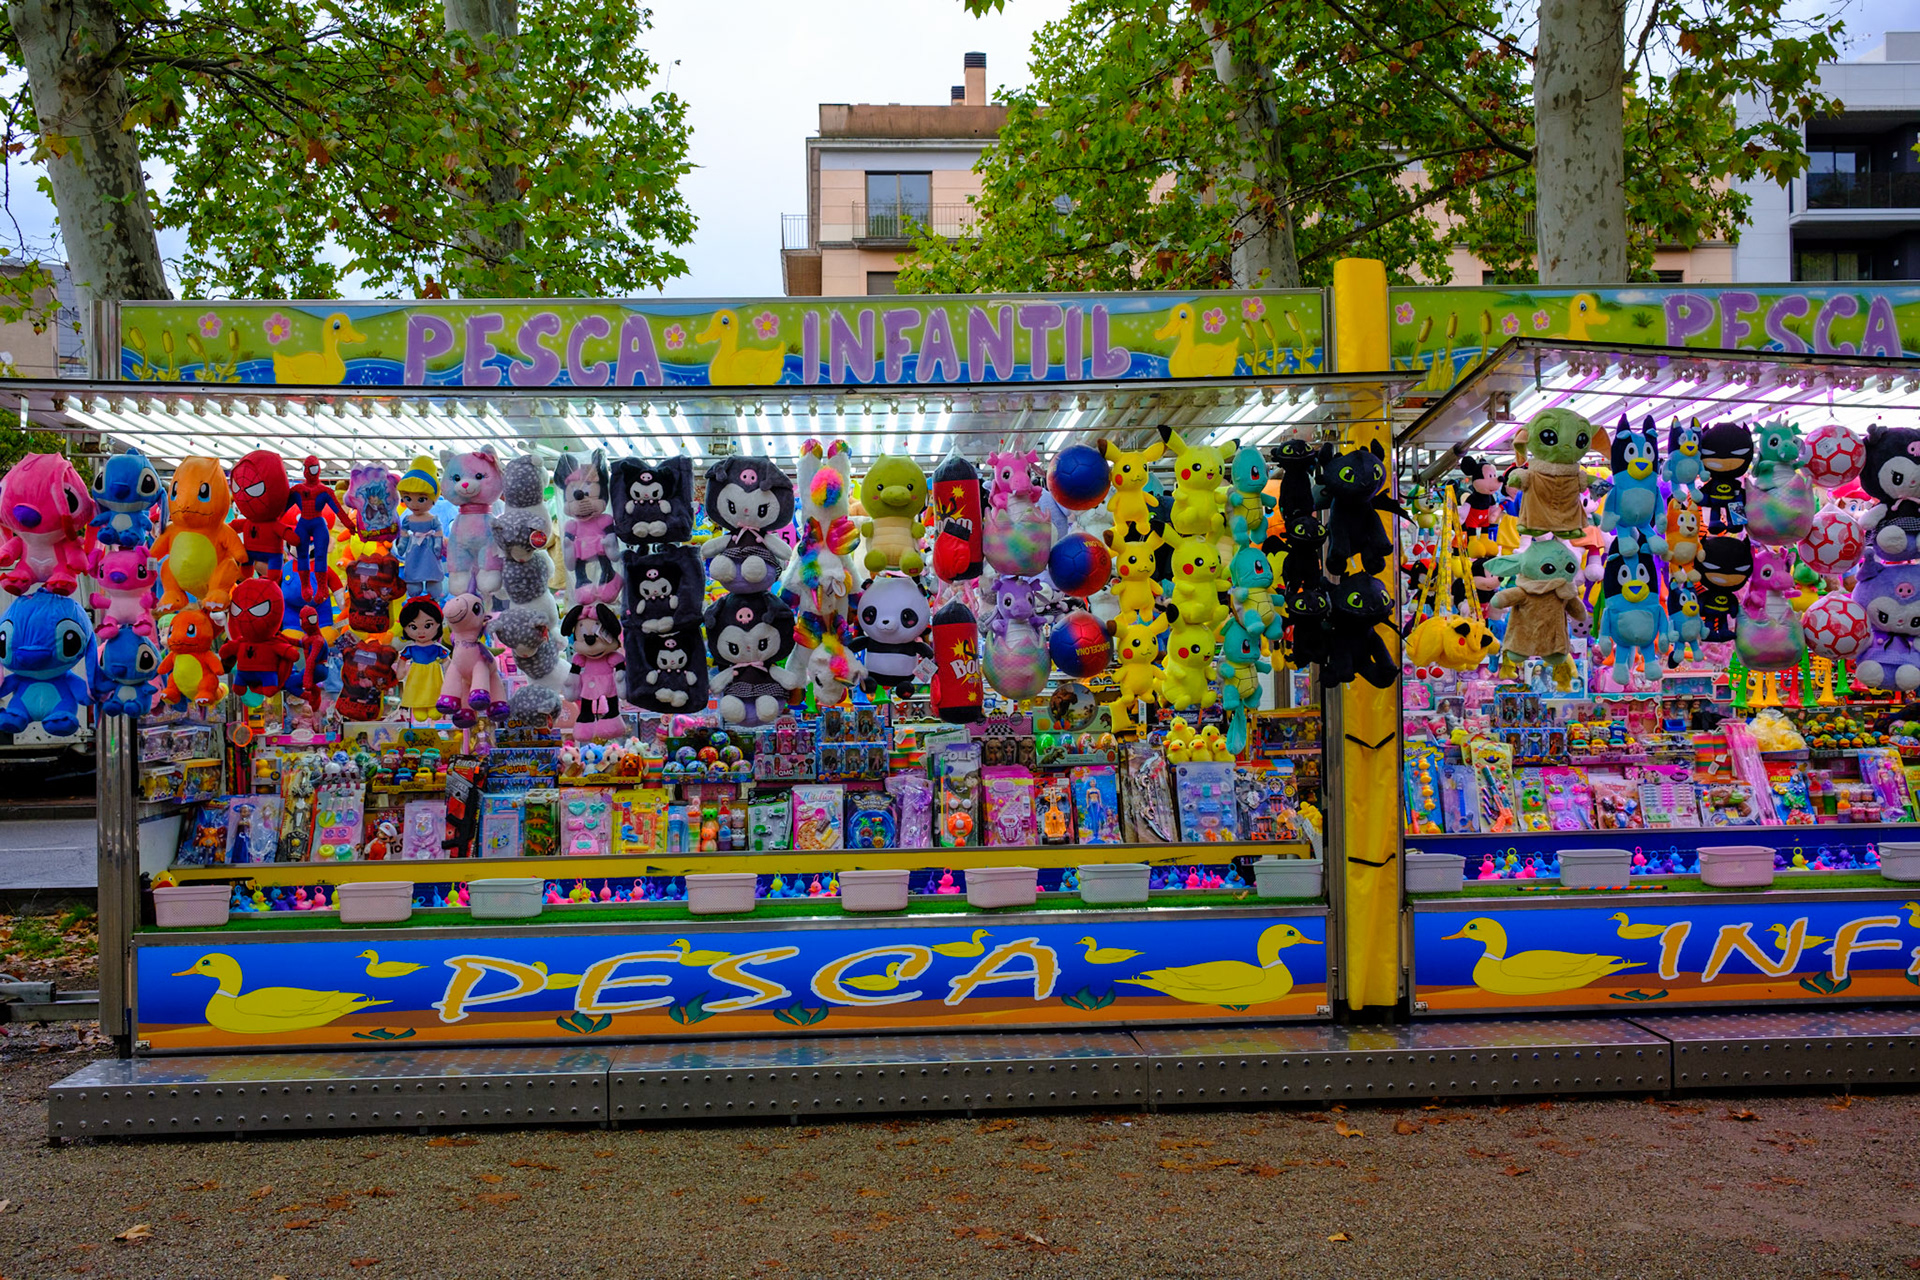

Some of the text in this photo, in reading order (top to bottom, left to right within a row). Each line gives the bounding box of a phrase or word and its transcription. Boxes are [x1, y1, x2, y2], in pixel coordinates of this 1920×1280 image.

[404, 303, 1132, 388] PESCA INFANTIL
[1663, 291, 1904, 358] PESCA
[437, 937, 1061, 1024] PESCA
[1656, 914, 1920, 983] INF
